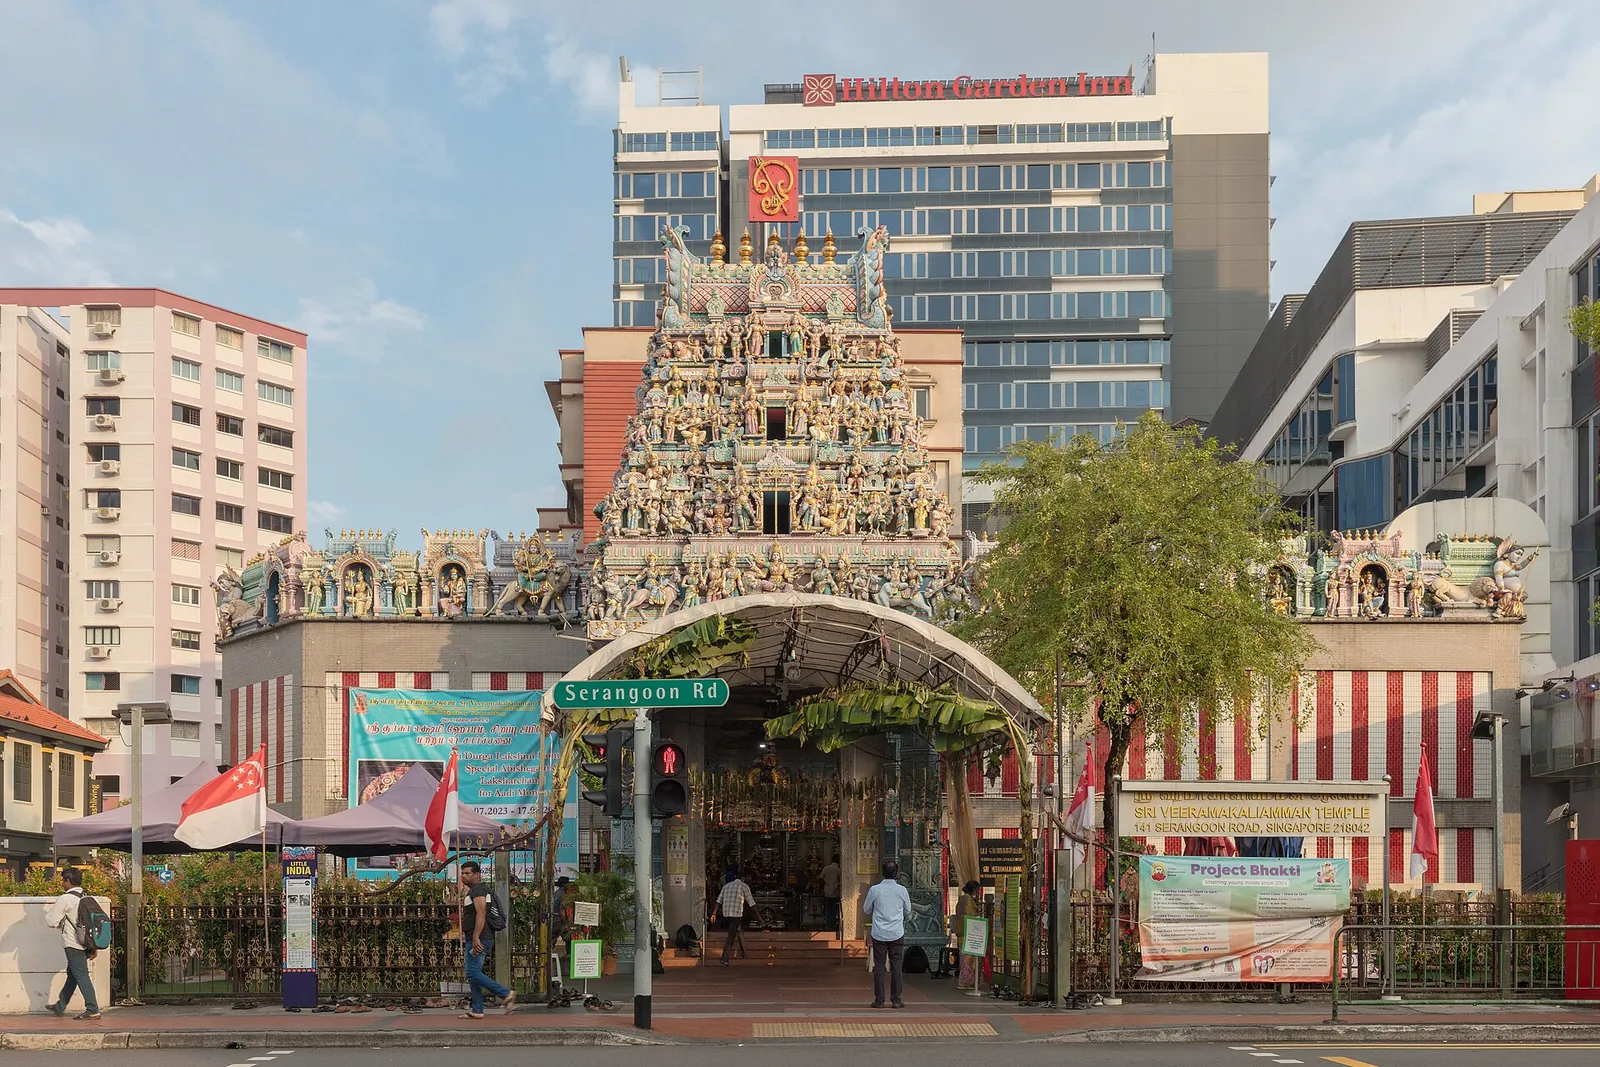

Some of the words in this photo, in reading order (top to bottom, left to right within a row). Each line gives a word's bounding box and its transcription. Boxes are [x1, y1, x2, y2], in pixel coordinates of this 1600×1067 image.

[841, 77, 945, 101] Hilton
[952, 73, 1064, 99] Garden
[1076, 72, 1132, 96] Inn
[565, 684, 680, 704] Serangoon
[693, 682, 717, 699] Rd
[465, 752, 494, 763] Durga
[496, 752, 535, 761] Lakshmi
[465, 764, 498, 775] Special
[479, 788, 492, 797] for
[494, 788, 515, 797] Aadi
[90, 784, 100, 815] ashliving
[474, 806, 508, 816] 07.2023
[1134, 806, 1156, 819] SRI
[1161, 806, 1311, 819] VEERAMAKALIAMMAN
[1315, 806, 1370, 819] TEMPLE
[1134, 822, 1151, 834] 141
[1155, 822, 1226, 834] SERANGOON
[1229, 822, 1262, 835] ROAD,
[1266, 822, 1330, 834] SINGAPORE
[1333, 822, 1370, 834] 218042
[286, 866, 312, 875] INDIA
[1190, 863, 1247, 878] Project
[1250, 864, 1301, 877] Bhakti
